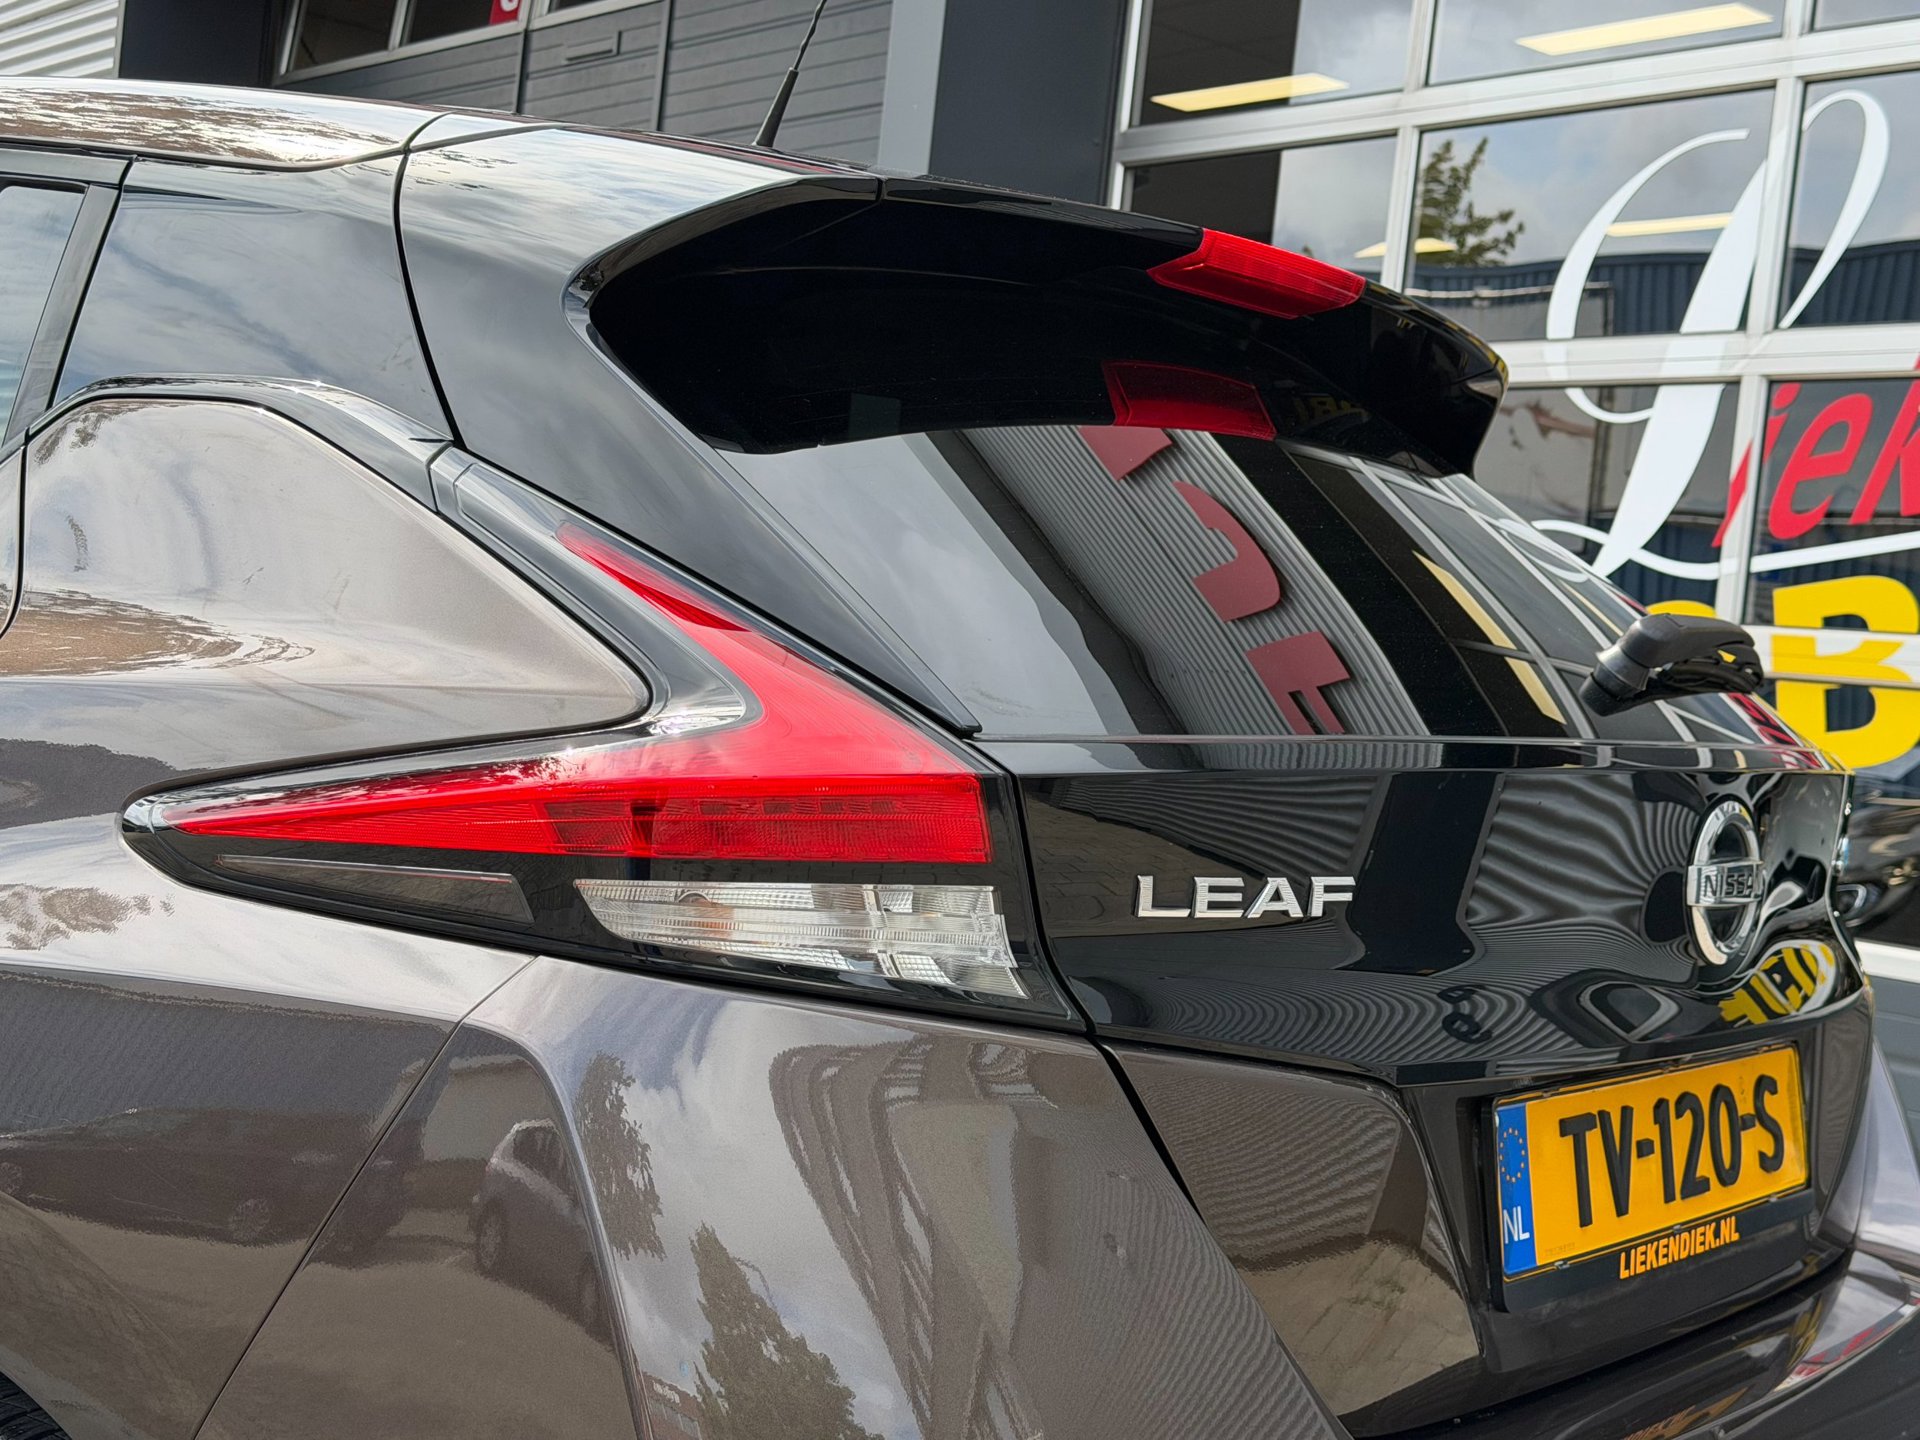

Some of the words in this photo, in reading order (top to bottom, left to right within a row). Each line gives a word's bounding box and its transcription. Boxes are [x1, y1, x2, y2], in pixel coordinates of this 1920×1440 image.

[1135, 875, 1356, 918] LEAF
[1704, 872, 1762, 898] NISSA
[1559, 1075, 1784, 1228] TV-120-S
[1503, 1206, 1530, 1244] NL
[1619, 1216, 1740, 1279] LIEKENDIEK.NL
